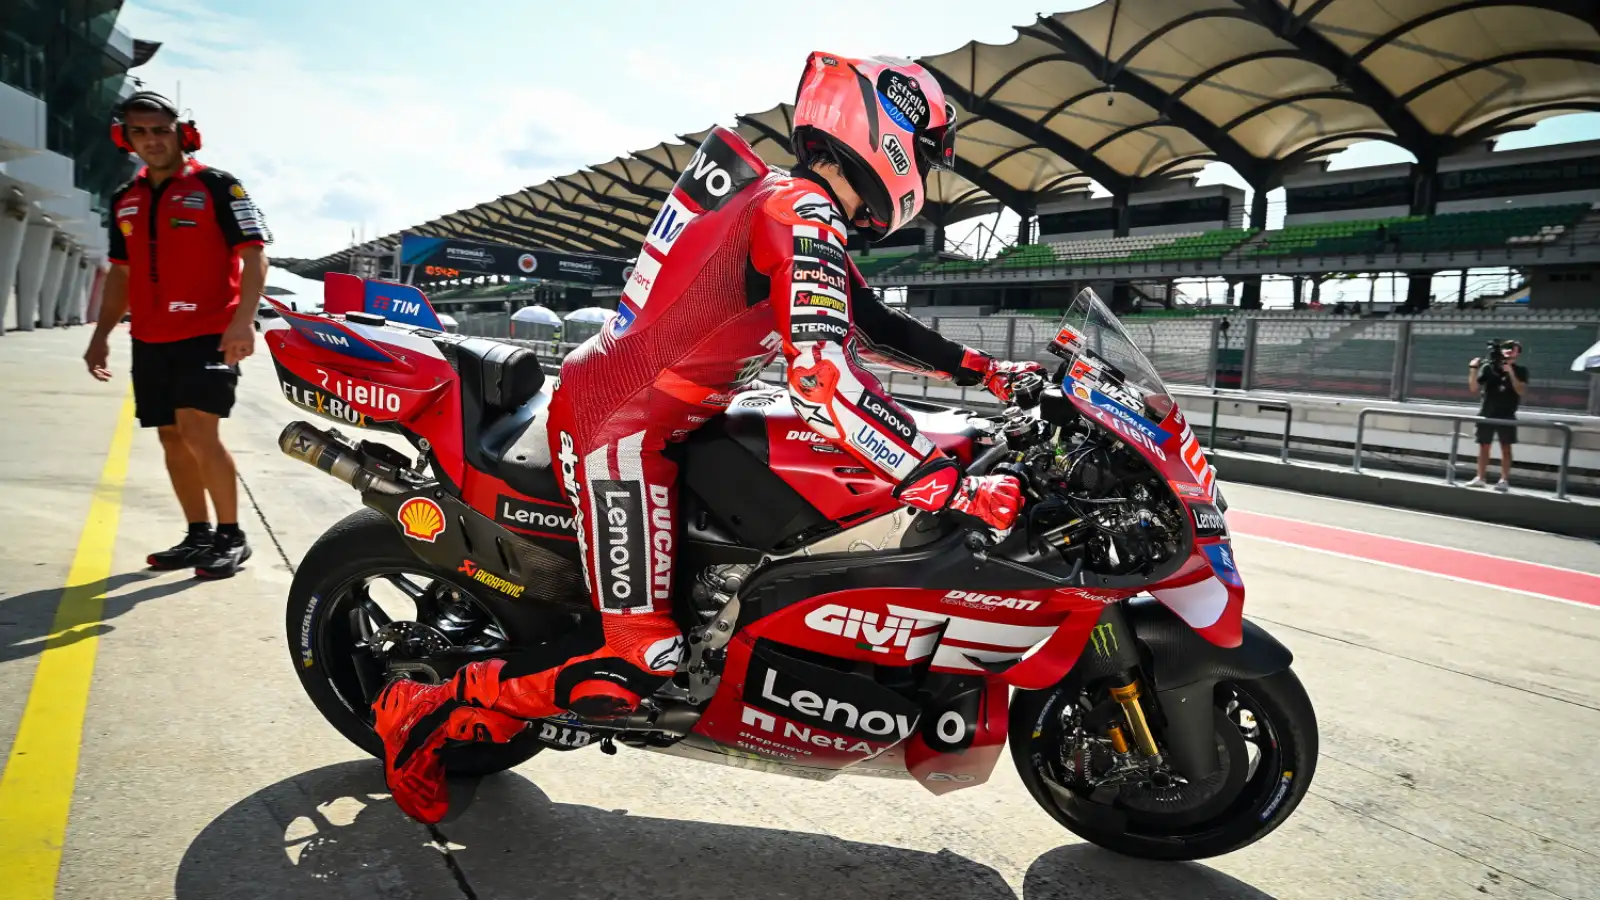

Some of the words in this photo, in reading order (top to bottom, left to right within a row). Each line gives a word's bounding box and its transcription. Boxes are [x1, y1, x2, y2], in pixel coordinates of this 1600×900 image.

[886, 84, 920, 124] Galicia
[890, 76, 927, 116] Estrella
[884, 137, 909, 173] SHOEI
[446, 247, 484, 258] PETRONAS
[559, 260, 593, 270] PETRONAS
[392, 299, 421, 316] TIM
[315, 331, 350, 348] TIM
[1099, 382, 1144, 410] WRS
[862, 395, 912, 437] Lenovo
[1099, 402, 1157, 440] ADVANCE
[857, 424, 906, 469] Unipol
[1112, 417, 1167, 462] riello
[1193, 508, 1225, 530] Lenovo
[605, 490, 632, 600] Lenovo
[649, 484, 673, 600] DUCATI
[943, 589, 1041, 612] DUCATI
[301, 596, 318, 650] MICHELIN
[804, 603, 916, 647] GIVI
[539, 723, 590, 748] D.I.D
[737, 740, 797, 760] SIEMENS
[739, 730, 813, 756] streparava
[783, 721, 887, 757] NetA
